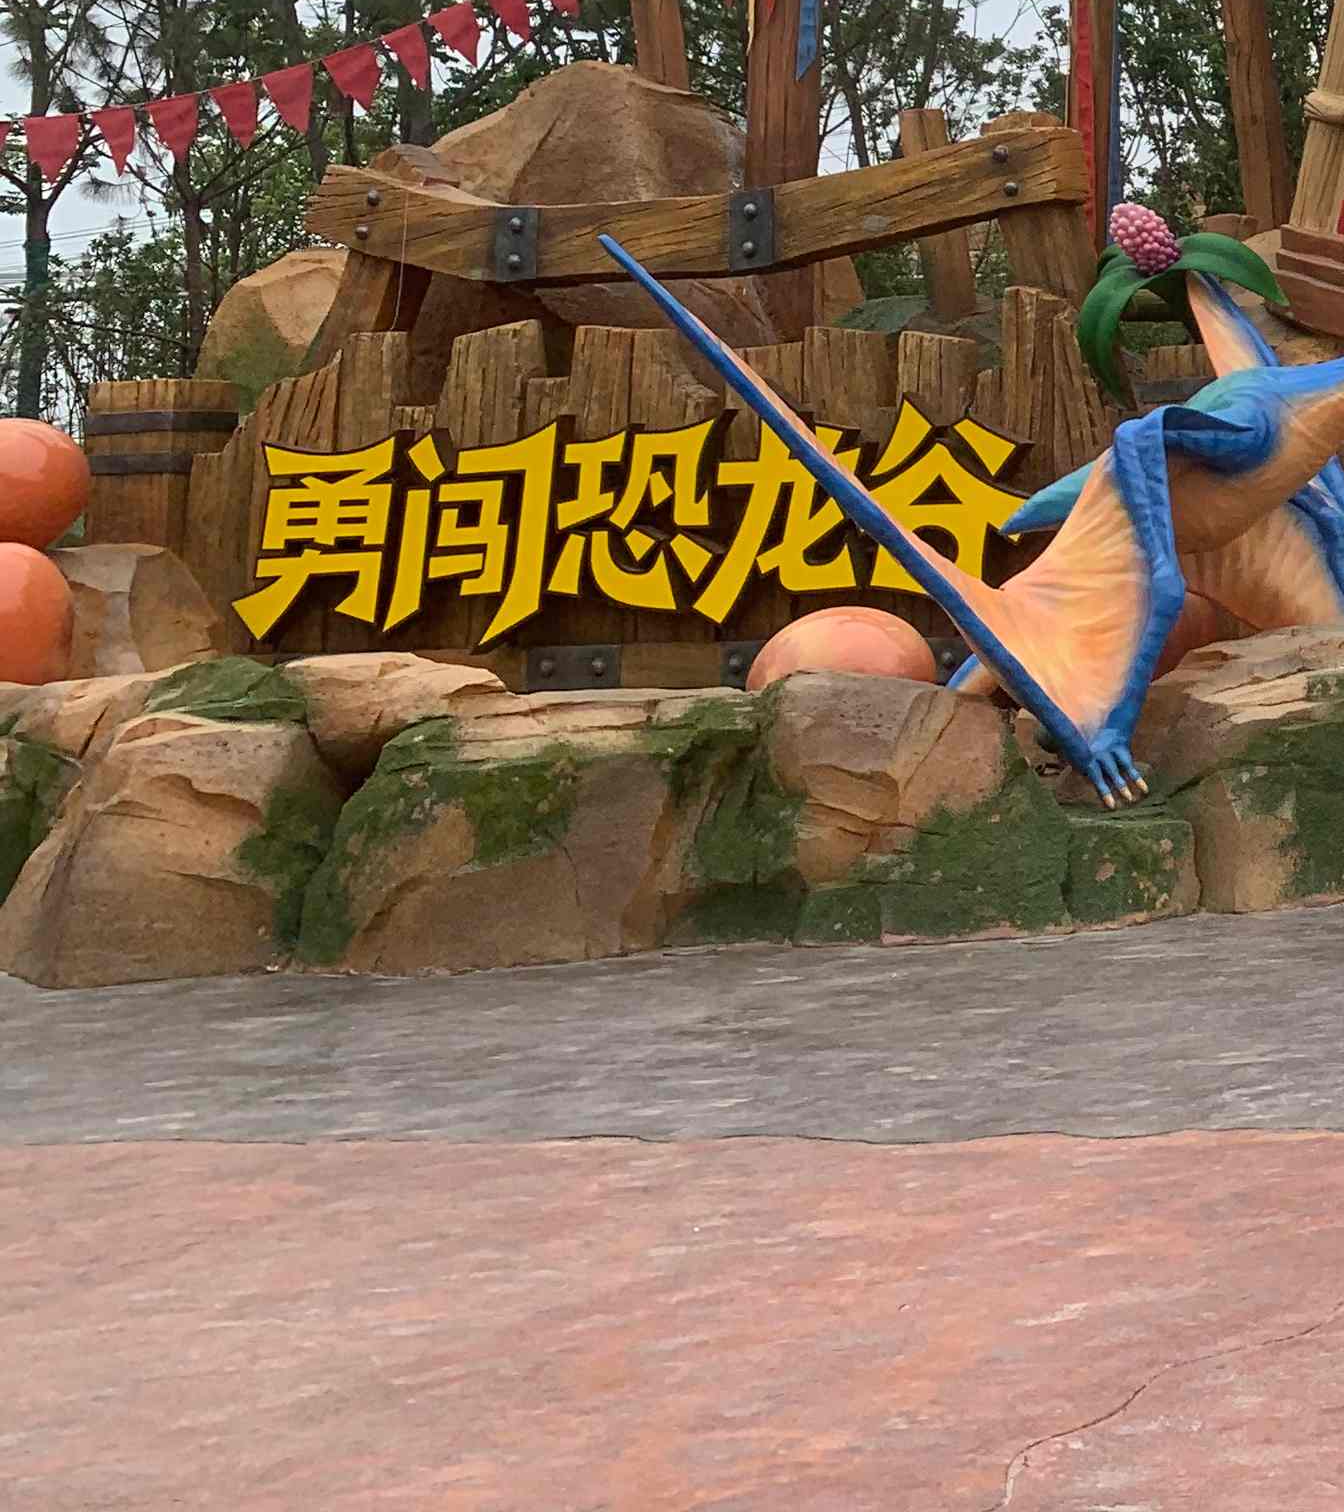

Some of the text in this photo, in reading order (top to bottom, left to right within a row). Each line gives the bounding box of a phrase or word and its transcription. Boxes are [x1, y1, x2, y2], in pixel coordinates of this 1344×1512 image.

[232, 400, 1026, 644] 勇闯恐龙谷
